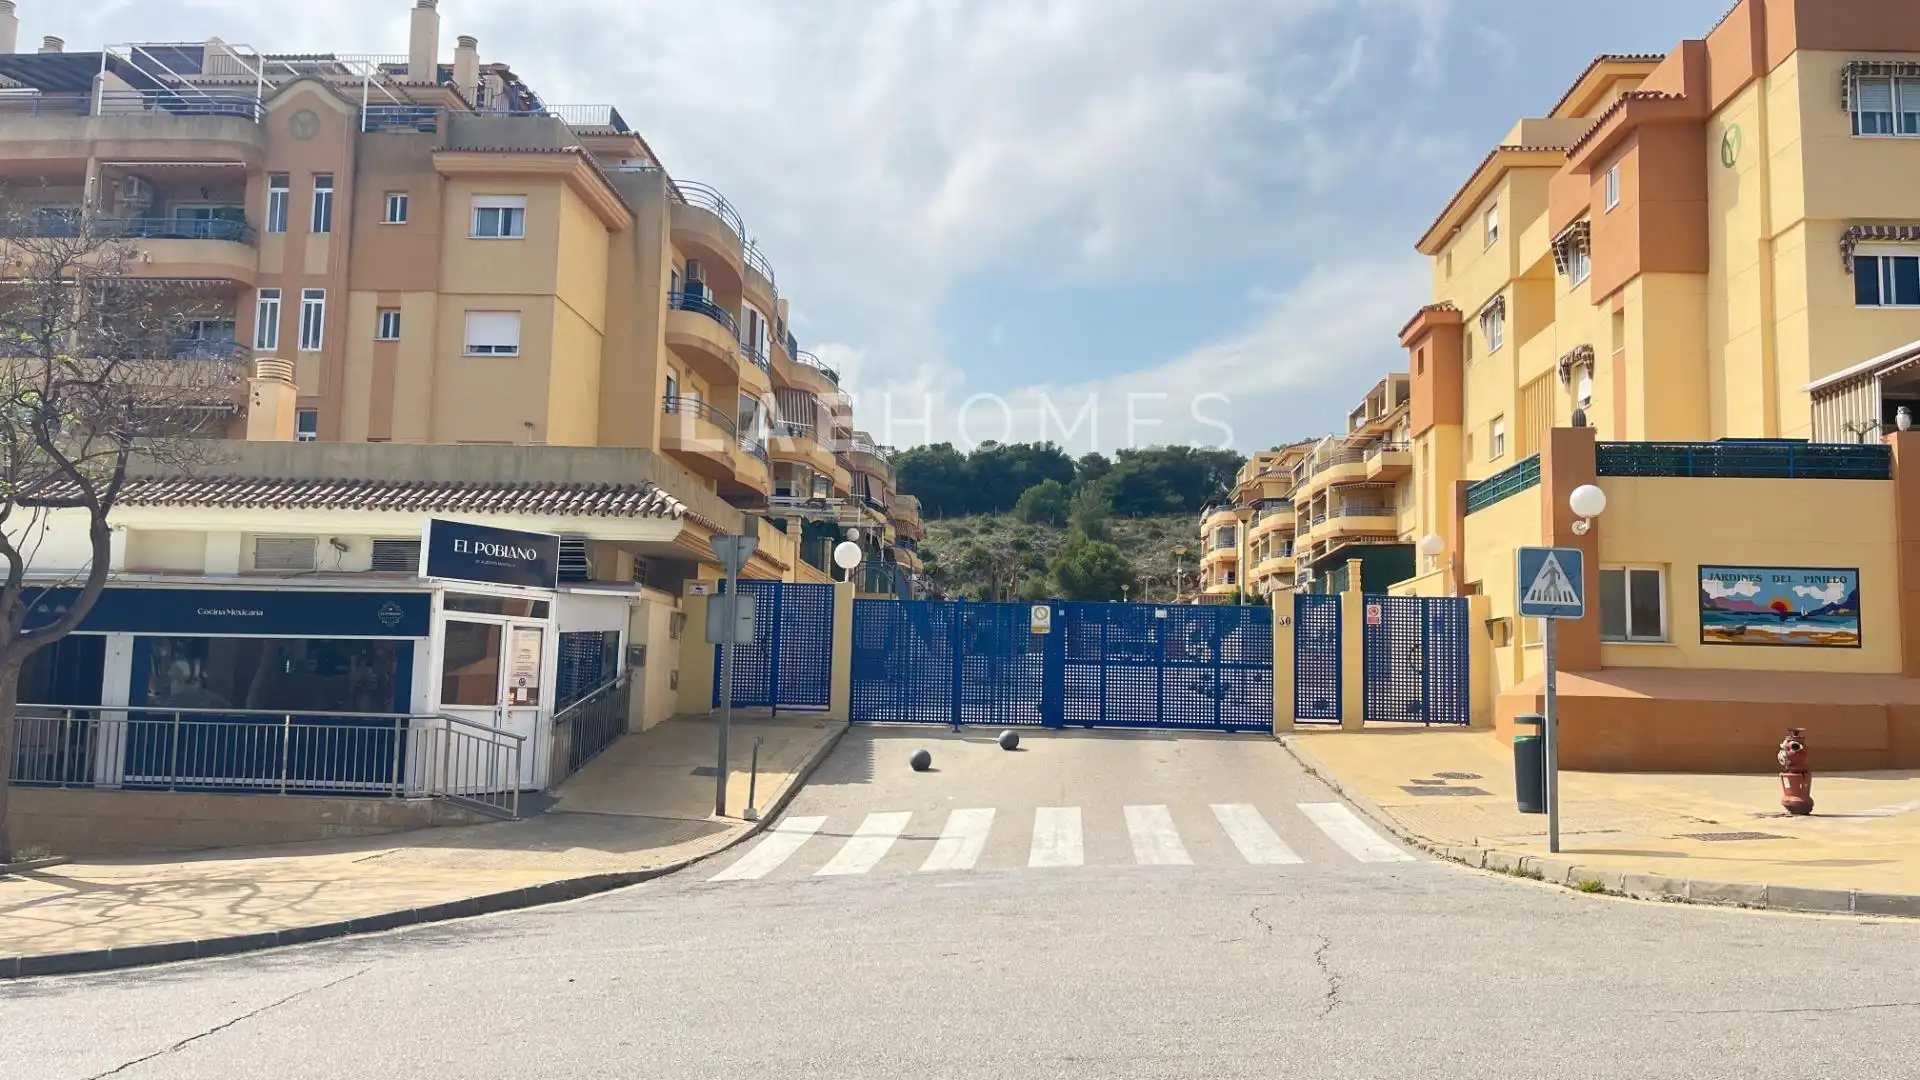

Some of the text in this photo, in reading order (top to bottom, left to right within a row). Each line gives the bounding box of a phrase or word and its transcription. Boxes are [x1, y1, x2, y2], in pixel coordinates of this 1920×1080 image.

[454, 539, 537, 561] EL POBLANO
[1708, 573, 1848, 584] JARDINES DEL PINILLO
[197, 607, 264, 616] Cocina Mexicana
